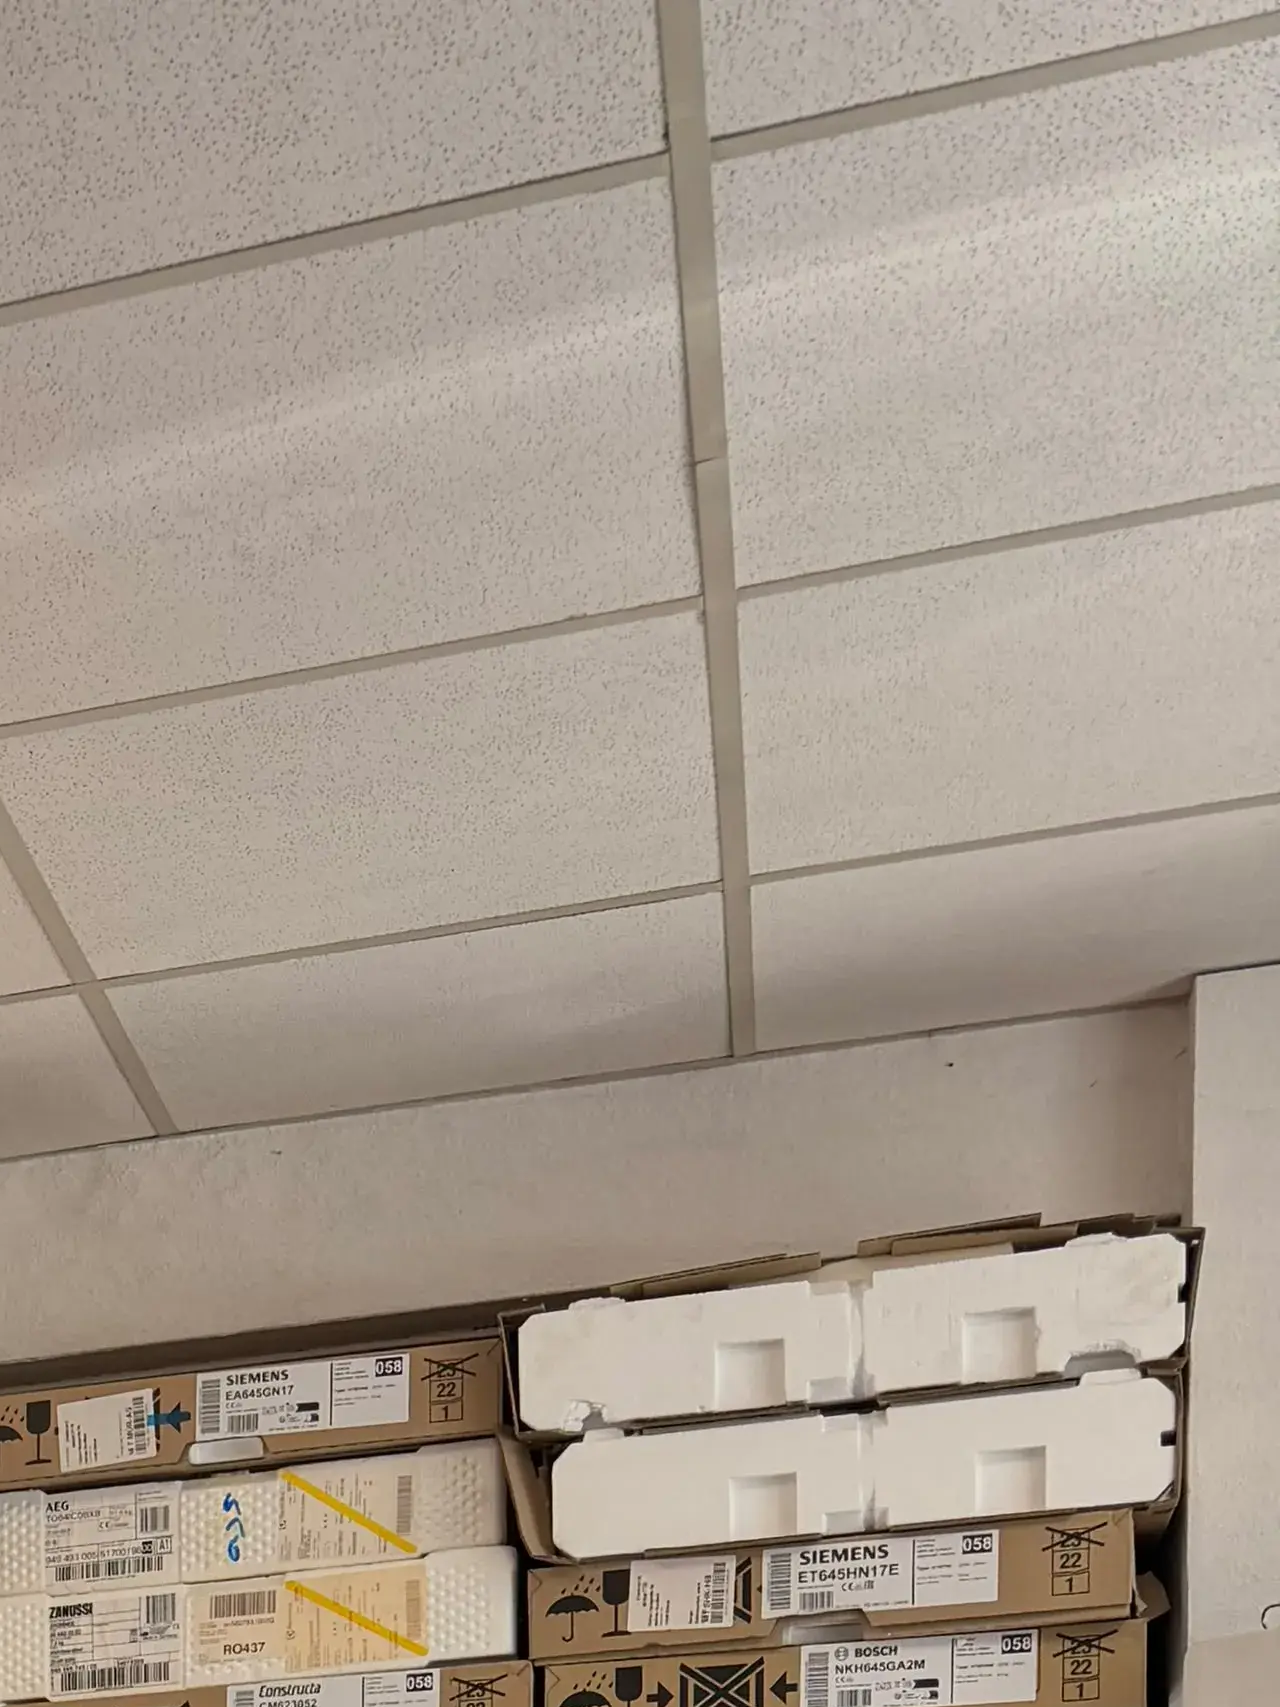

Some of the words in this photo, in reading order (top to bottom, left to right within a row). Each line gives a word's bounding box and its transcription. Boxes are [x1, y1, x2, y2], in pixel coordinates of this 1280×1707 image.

[376, 1359, 402, 1375] 058
[226, 1369, 289, 1386] SIEMENS
[225, 1385, 294, 1401] EA645GN17
[436, 1382, 456, 1398] 22
[442, 1407, 449, 1421] 1
[46, 1501, 69, 1512] AEG
[962, 1536, 993, 1551] 058
[798, 1543, 889, 1566] SIEMENS
[1059, 1552, 1083, 1569] 22
[798, 1564, 900, 1585] ET645HN17E
[1065, 1576, 1074, 1592] 1
[49, 1603, 93, 1619] ZANUSSI
[223, 1642, 265, 1655] RO437
[1002, 1635, 1032, 1651] 058
[854, 1645, 898, 1658] BOSCH
[835, 1660, 926, 1675] NKH645GA2M
[1070, 1659, 1093, 1675] 22
[259, 1682, 321, 1698] Constructa
[406, 1675, 432, 1690] 058
[1076, 1683, 1085, 1698] 1
